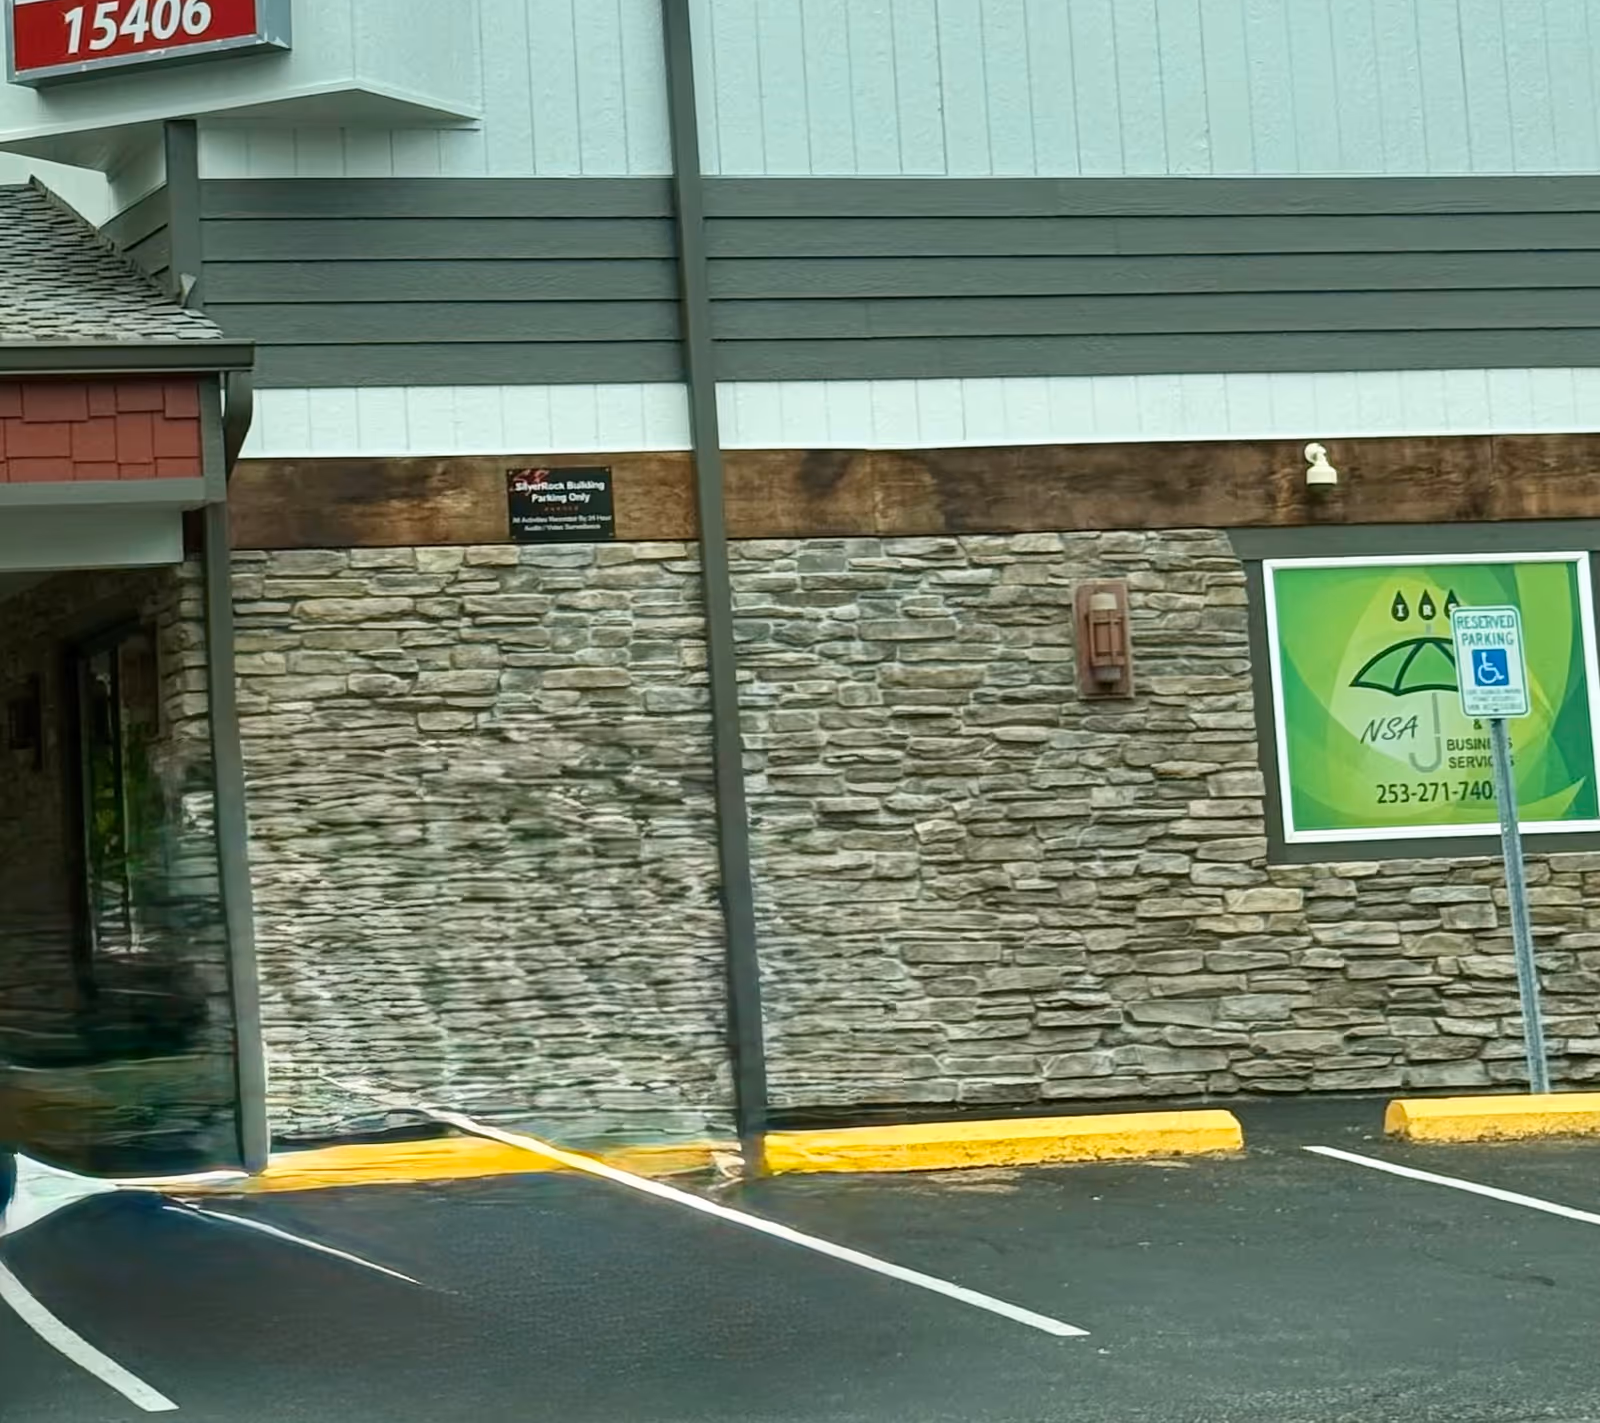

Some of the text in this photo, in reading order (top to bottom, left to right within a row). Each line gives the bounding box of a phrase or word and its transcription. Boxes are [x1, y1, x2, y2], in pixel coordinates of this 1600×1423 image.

[566, 480, 605, 491] Building
[531, 493, 591, 504] Parking Only
[1457, 615, 1515, 629] RESERVED
[1462, 632, 1514, 645] PARKING
[1360, 715, 1419, 745] NSA
[1473, 719, 1482, 730] &
[1376, 780, 1498, 804] 253-271-740
